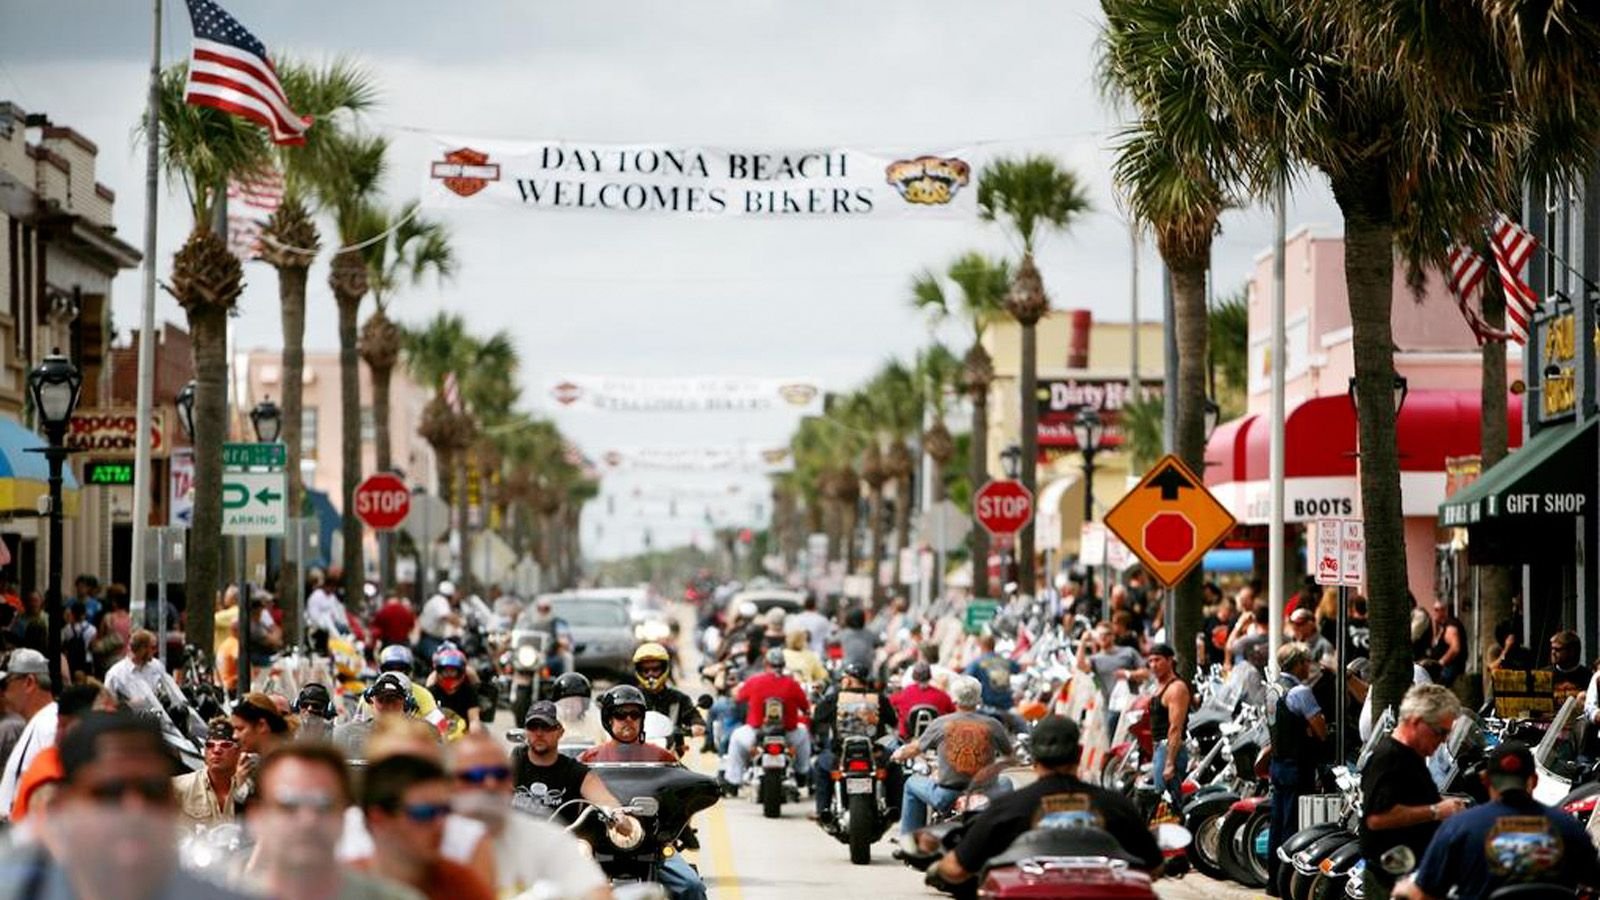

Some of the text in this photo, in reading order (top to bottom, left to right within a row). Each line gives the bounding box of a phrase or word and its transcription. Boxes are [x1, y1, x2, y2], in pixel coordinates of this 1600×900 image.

[541, 147, 846, 181] DAYTONA BEACH
[517, 179, 726, 213] WELCOMES
[745, 187, 874, 214] BIKERS
[1050, 379, 1104, 411] Dirty
[92, 464, 131, 482] ATM
[358, 490, 407, 514] STOP
[980, 496, 1028, 518] STOP
[1294, 498, 1352, 516] BOOTS
[1506, 494, 1540, 513] GIFT
[1544, 493, 1586, 513] SHOP
[1349, 524, 1358, 538] NO
